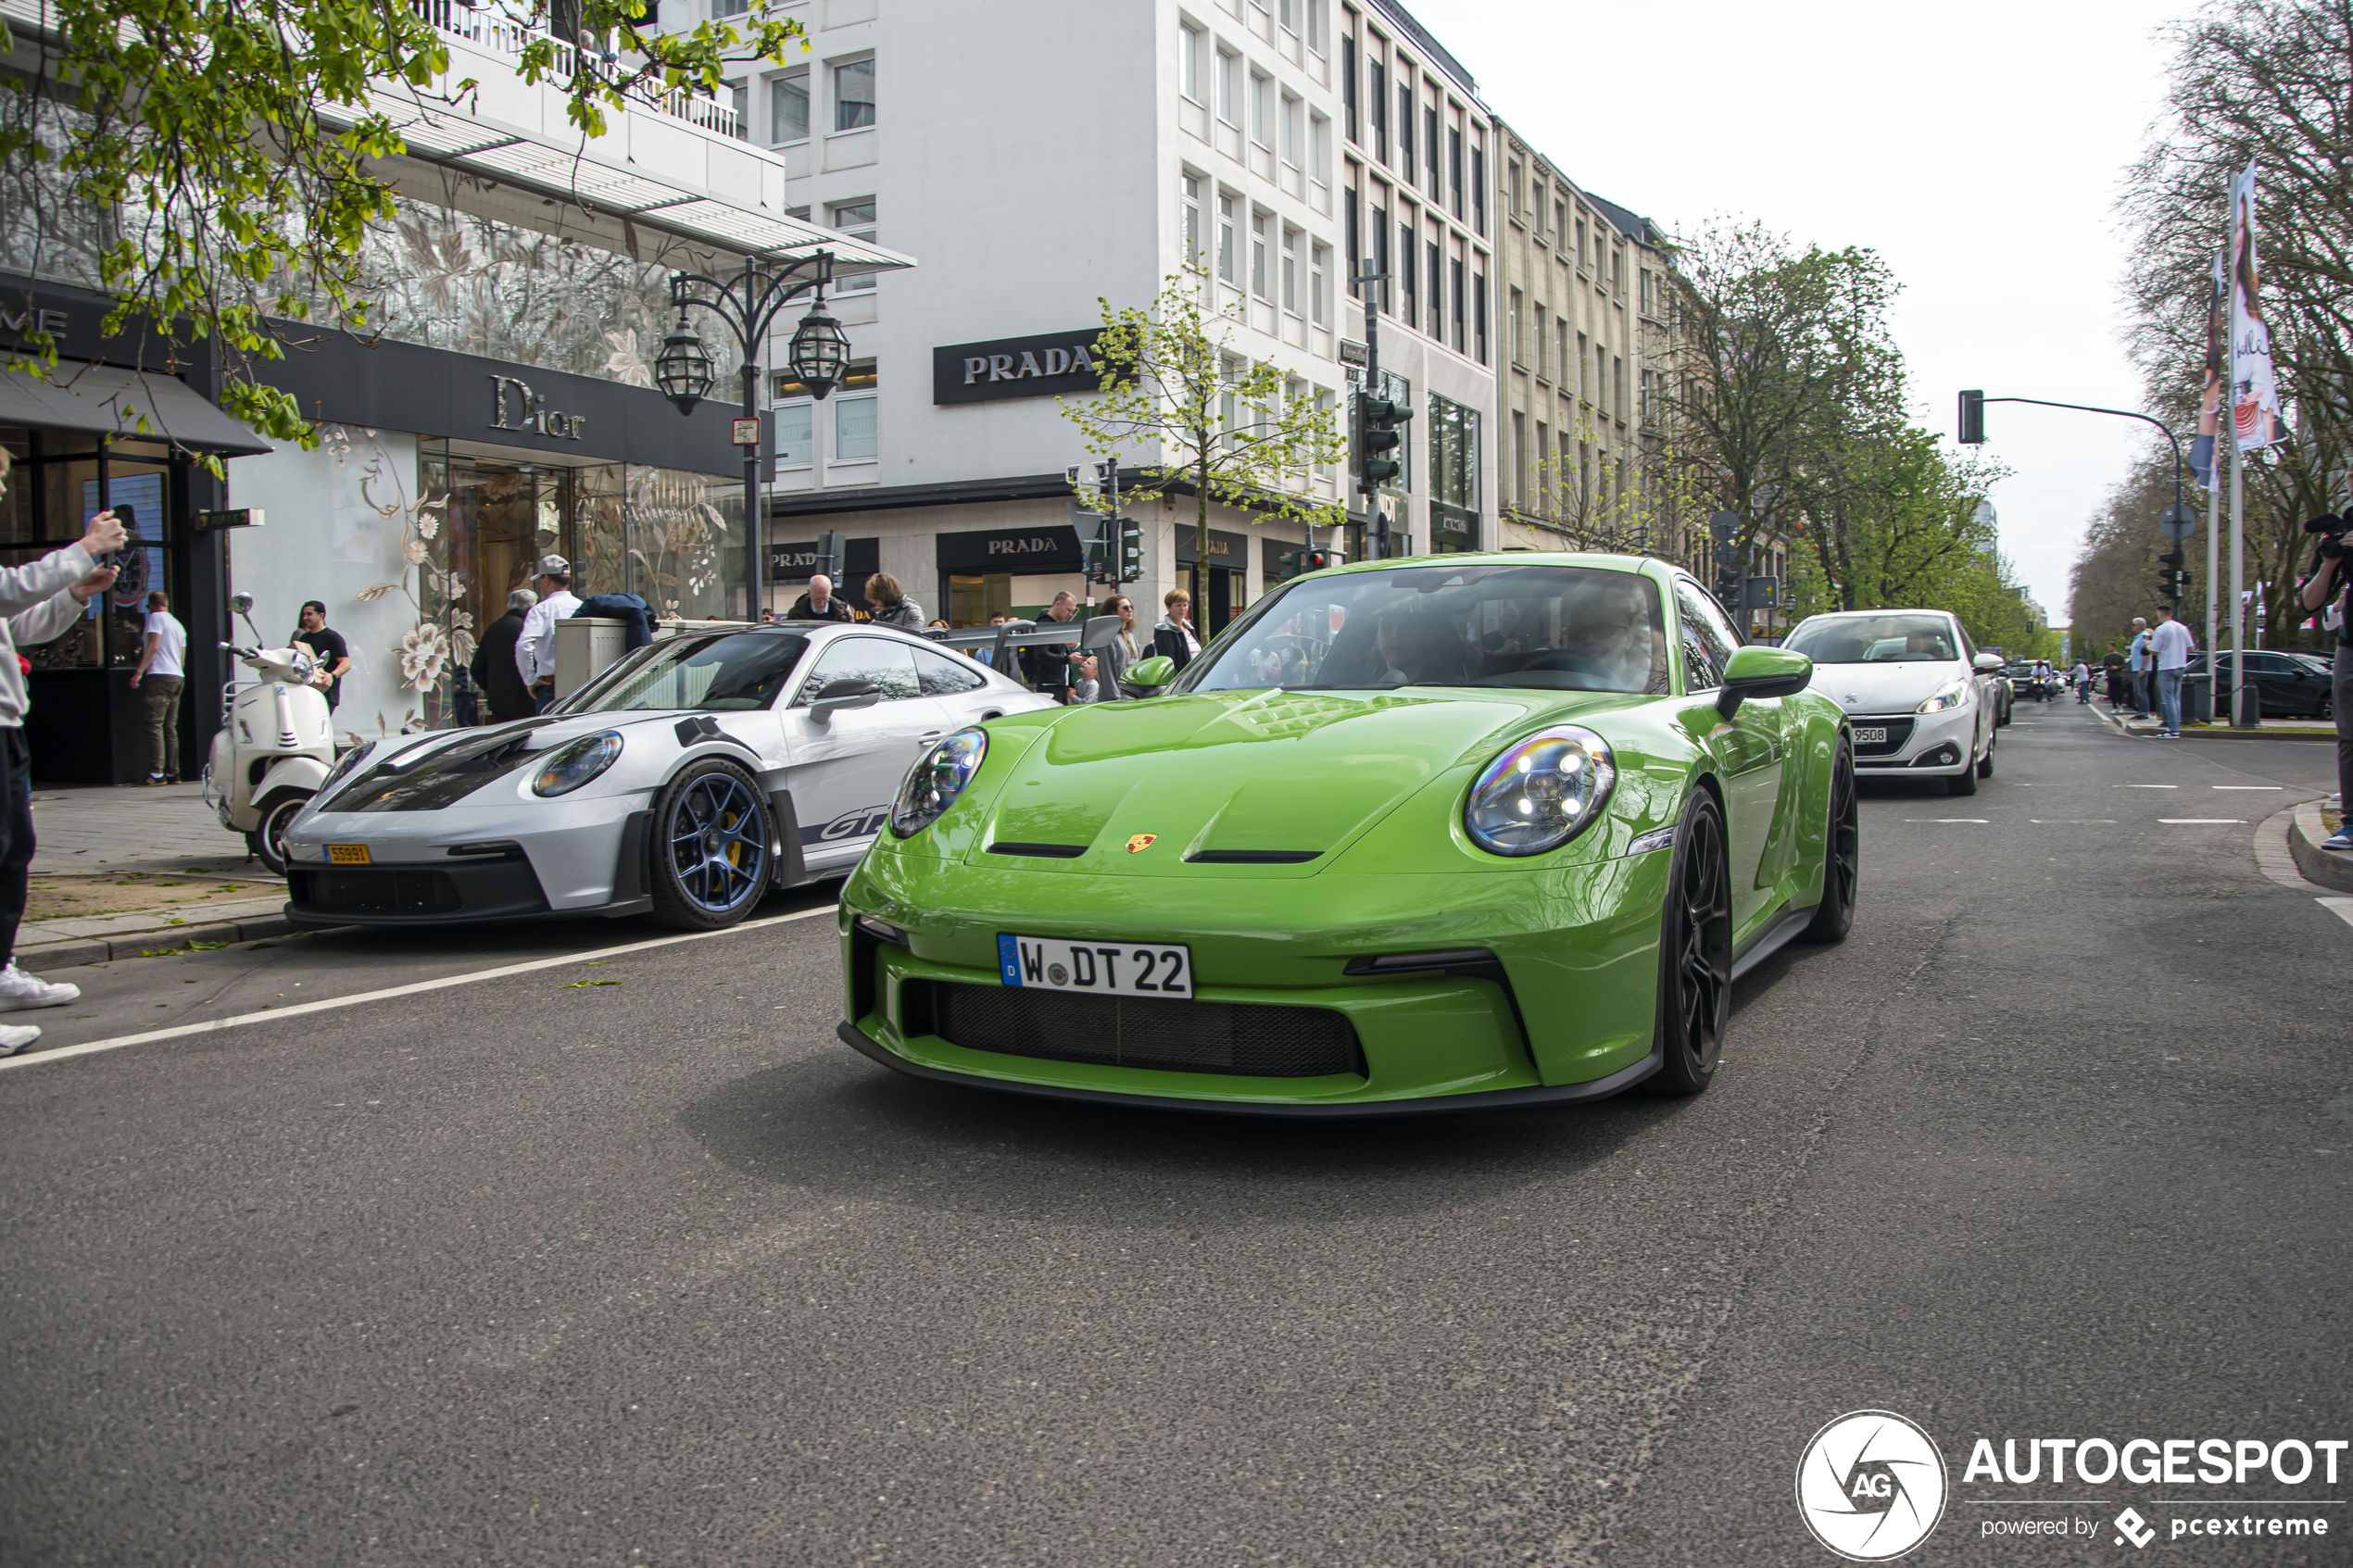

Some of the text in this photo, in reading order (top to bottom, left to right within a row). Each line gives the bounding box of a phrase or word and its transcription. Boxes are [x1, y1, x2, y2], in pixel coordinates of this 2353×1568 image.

[963, 345, 1097, 384] PRADA
[488, 374, 586, 440] Dior
[1363, 493, 1396, 522] FNDI
[771, 552, 817, 567] PRAD
[988, 537, 1058, 555] PRADA
[1855, 729, 1885, 741] 9508
[820, 802, 891, 840] GT
[331, 847, 366, 861] 55991
[1007, 942, 1186, 992] D W DT 22
